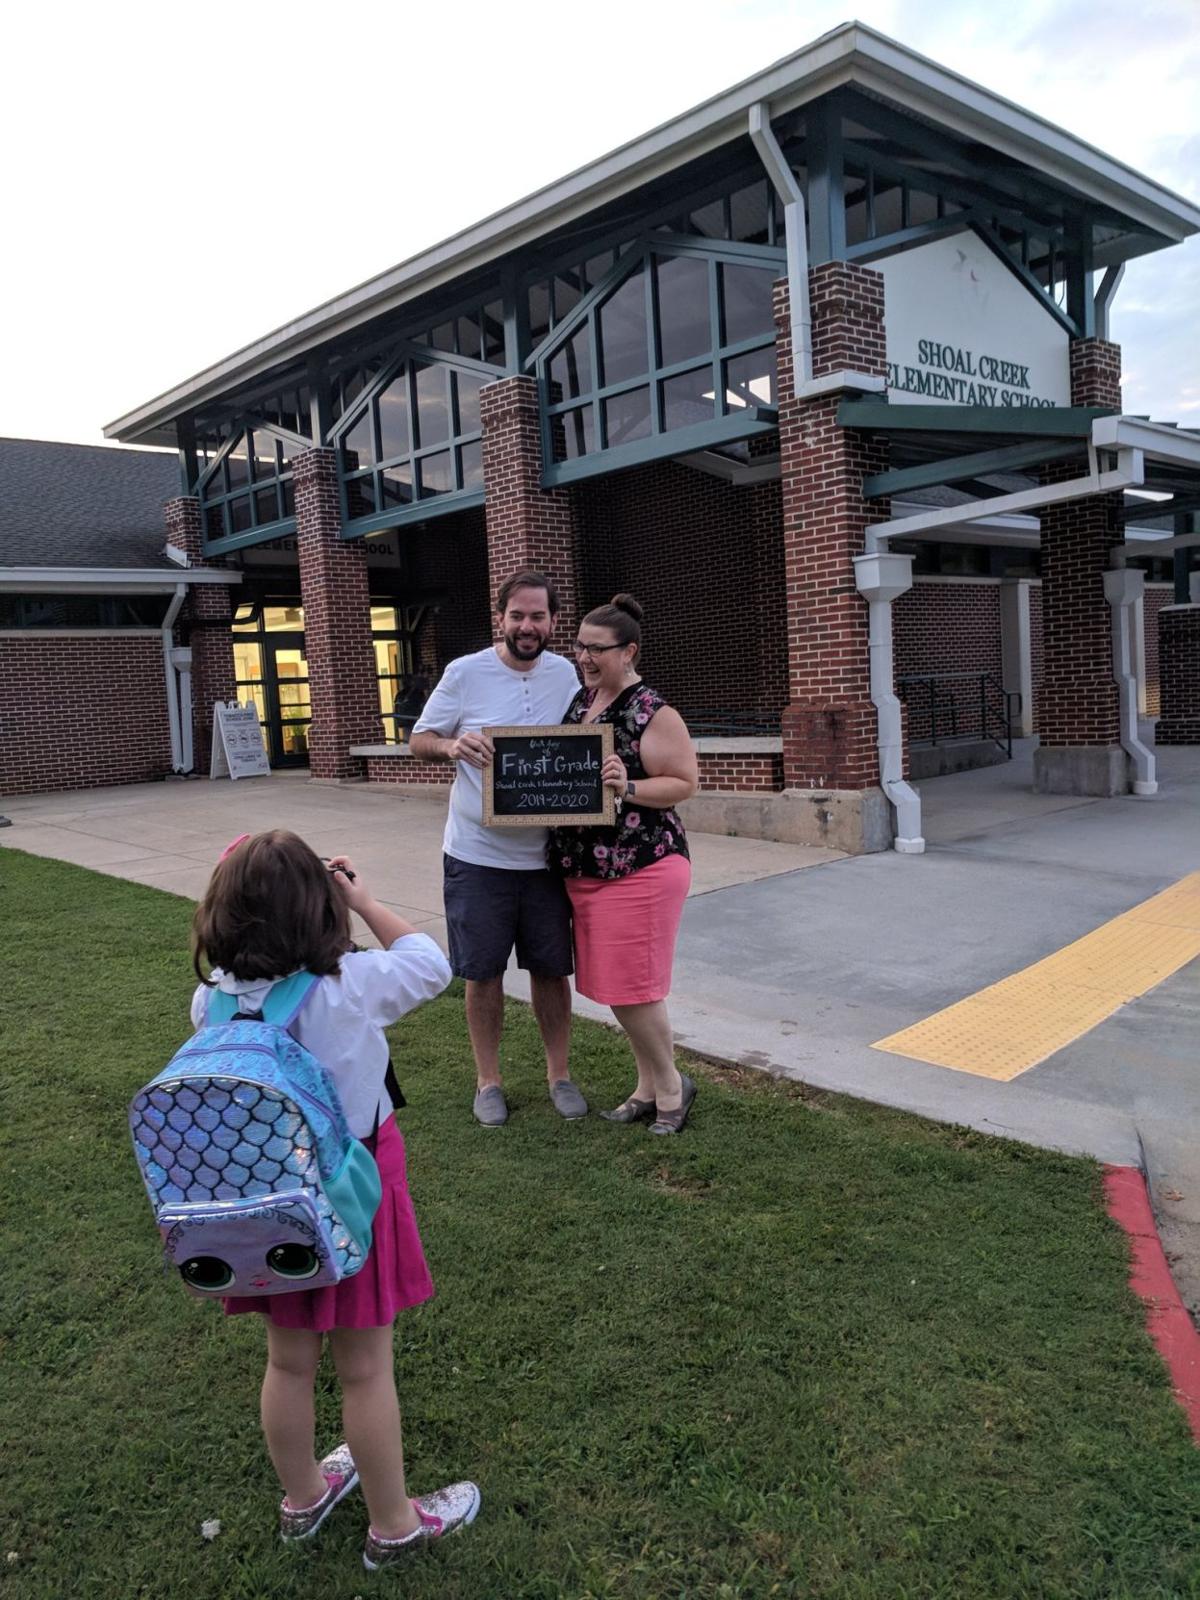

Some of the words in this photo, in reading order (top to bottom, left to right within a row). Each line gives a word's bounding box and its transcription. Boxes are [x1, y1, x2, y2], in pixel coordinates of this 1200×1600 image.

[918, 339, 976, 376] SHOAL
[979, 355, 1031, 389] CREEK
[885, 362, 997, 407] ELEMENTARY
[502, 752, 552, 776] First
[554, 749, 600, 774] Grade
[517, 793, 589, 808] 2019-2020
